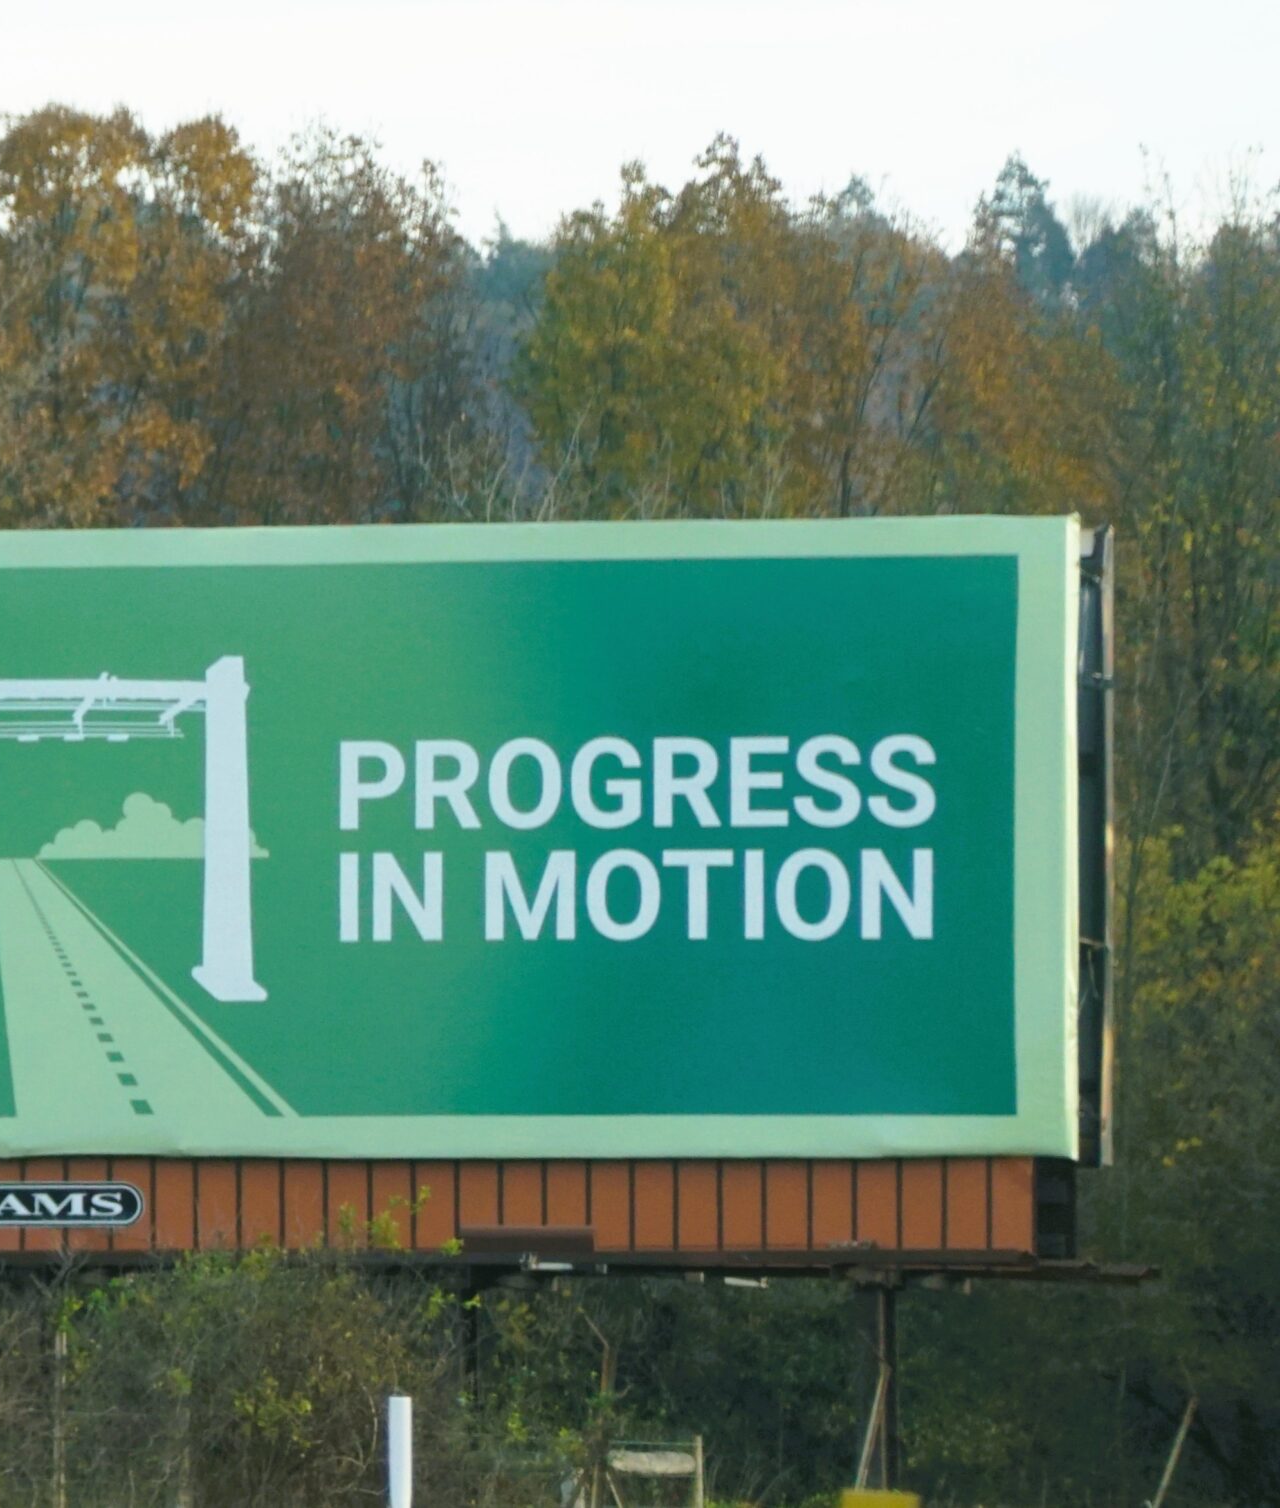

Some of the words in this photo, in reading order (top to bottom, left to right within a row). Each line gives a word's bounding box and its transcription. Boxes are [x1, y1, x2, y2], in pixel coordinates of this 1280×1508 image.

[338, 734, 937, 830] PROGRESS
[338, 851, 444, 943] IN
[484, 848, 934, 941] MOTION
